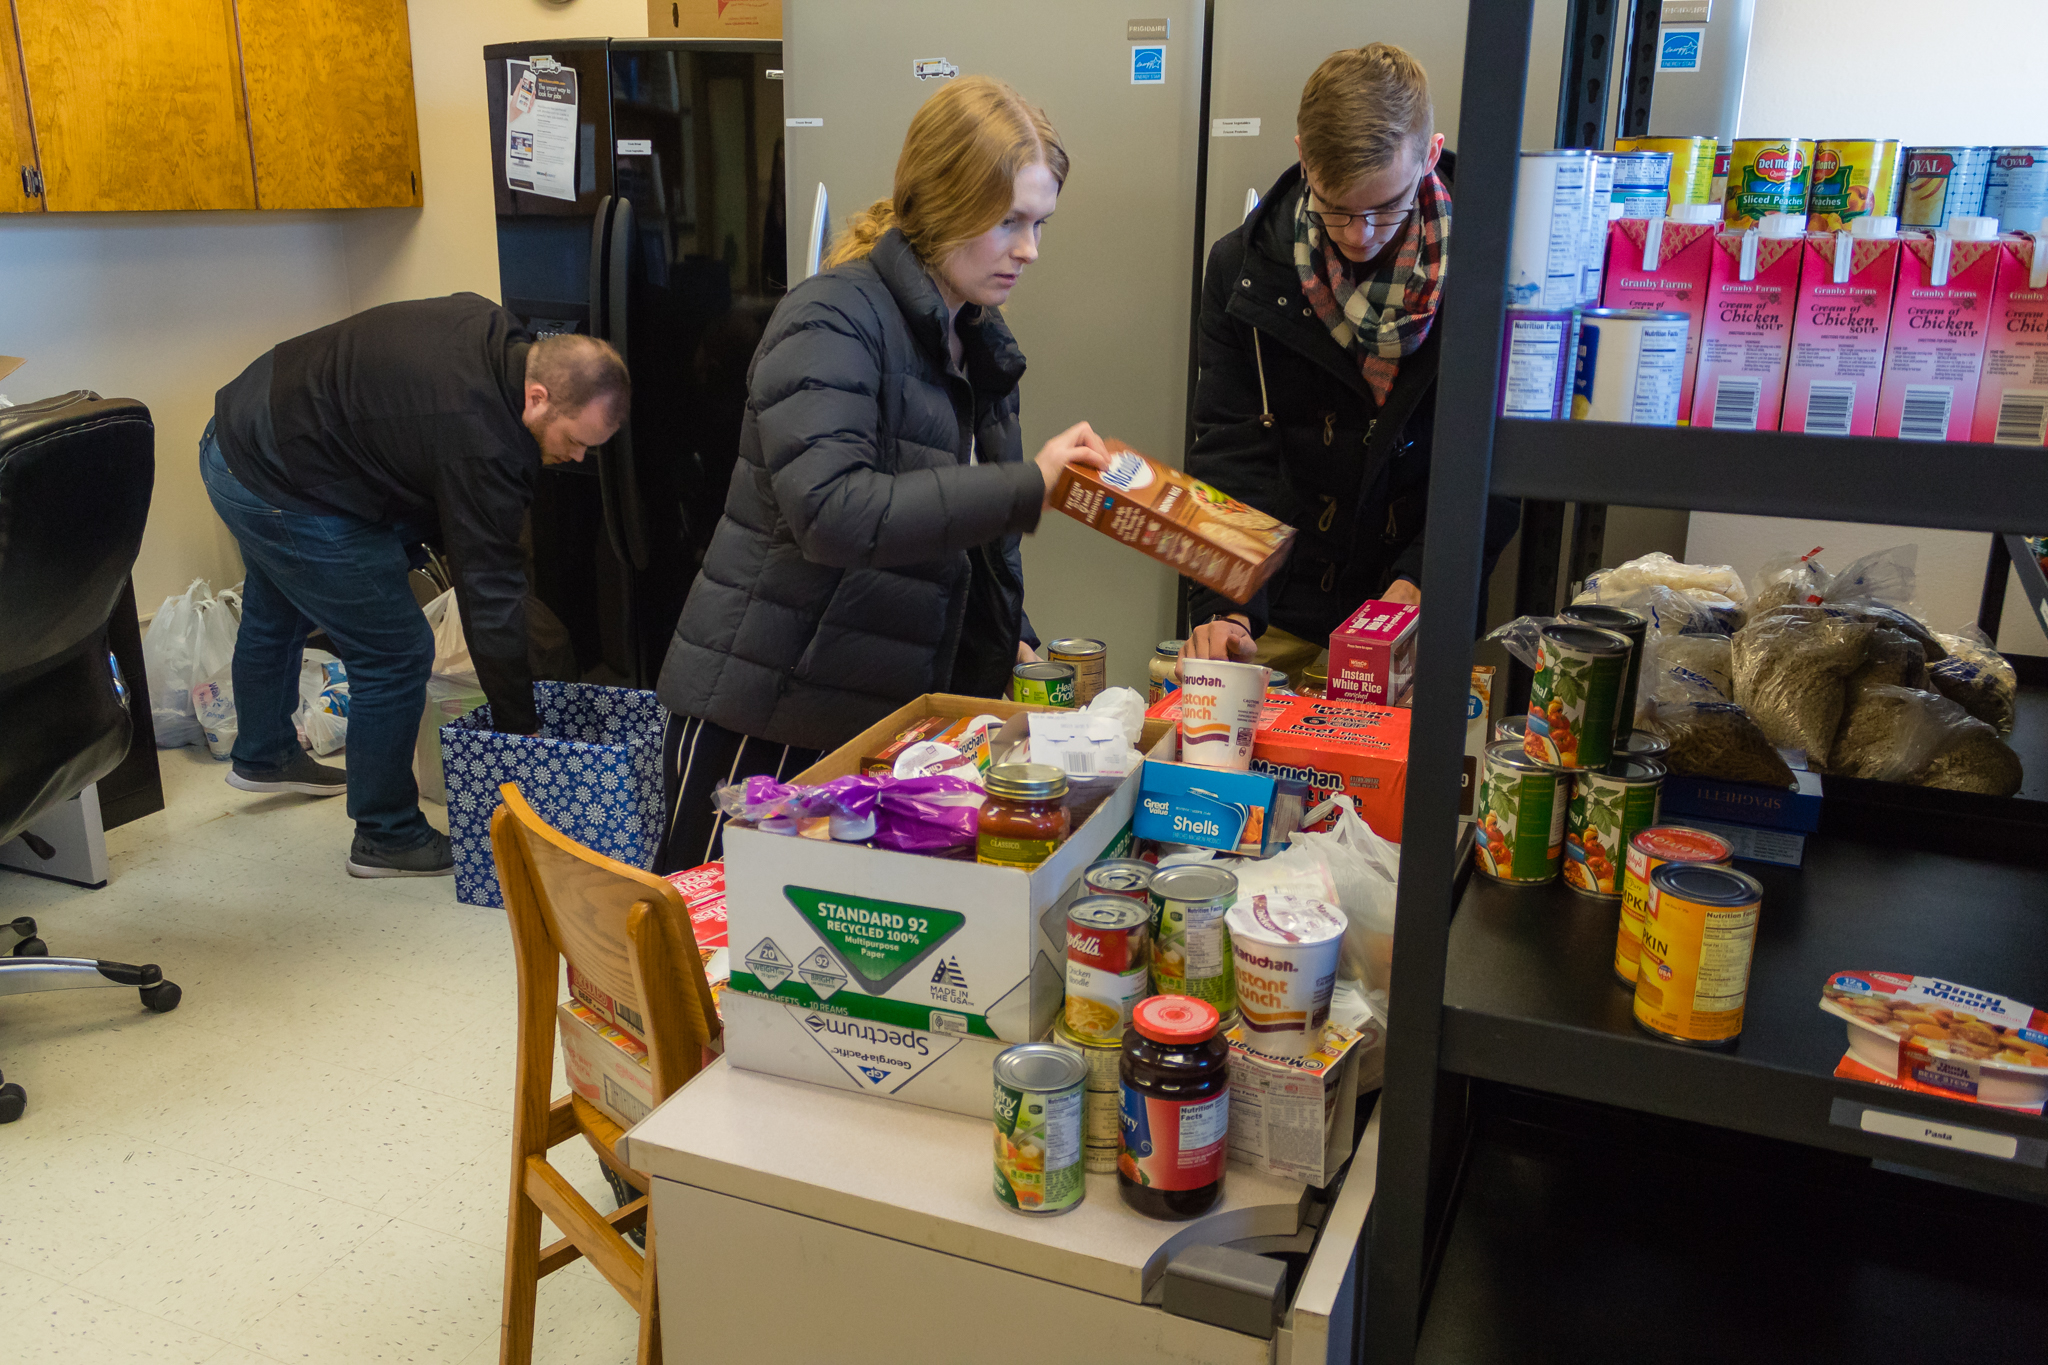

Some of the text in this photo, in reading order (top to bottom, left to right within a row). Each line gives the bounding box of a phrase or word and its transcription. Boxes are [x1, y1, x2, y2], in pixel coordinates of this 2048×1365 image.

[1758, 158, 1802, 169] Del Mote
[1908, 160, 1942, 176] OYAL
[2000, 158, 2028, 167] ROYAL
[1743, 195, 1803, 205] Sliced Peaches
[1811, 197, 1841, 206] Peaches
[1620, 278, 1693, 289] Granby Farms
[1722, 284, 1782, 293] Granby Farms
[1814, 287, 1877, 295] Granby Farms
[1911, 289, 1977, 298] Granby Farms
[2010, 292, 2044, 300] Granby
[1656, 300, 1666, 309] of
[1719, 301, 1767, 311] Cream of
[1811, 304, 1861, 314] Cream of
[1720, 309, 1779, 323] Chicken
[1908, 306, 1960, 316] Cream of
[2005, 310, 2044, 318] Cream
[1812, 312, 1874, 327] Chicken
[1909, 315, 1974, 330] Chicken
[1514, 322, 1562, 330] Nutrition Facts
[1755, 323, 1784, 331] SOUP
[1849, 326, 1879, 334] SOUP
[1350, 659, 1367, 667] WinCo
[1341, 668, 1375, 682] Instant
[1332, 678, 1382, 694] White Rice
[1344, 692, 1369, 700] enriched
[1183, 707, 1212, 720] unch
[1300, 716, 1329, 726] 6
[1272, 728, 1313, 737] Ramen
[1314, 732, 1358, 742] Noodle
[1359, 737, 1392, 747] Soup
[1289, 724, 1378, 740] Beef Flavor
[1250, 759, 1343, 791] Maruchan
[1144, 798, 1169, 811] Great
[1698, 788, 1782, 809] SPAGHETTI
[1149, 806, 1169, 816] Value
[1173, 815, 1219, 836] Shells
[990, 839, 1020, 849] CLASSICO
[817, 902, 928, 934] STANDARD 92
[1256, 910, 1275, 931] Chicken
[1706, 910, 1757, 920] Nutrition Facts
[826, 920, 920, 945] RECYCLED 100%
[844, 935, 900, 952] Multipurpose
[1066, 931, 1100, 957] pbell's
[1643, 927, 1668, 956] PKIN
[762, 948, 775, 960] 20
[861, 947, 886, 959] Paper
[816, 956, 828, 967] 92
[753, 964, 779, 973] WEIGHT
[1658, 968, 1671, 978] USA
[810, 973, 835, 984] BRIGHT
[1235, 965, 1288, 994] nstant
[1844, 977, 1862, 986] 12g
[930, 985, 969, 998] MADE IN
[1932, 980, 2002, 1006] Dinty
[770, 993, 800, 1006] SHEETS
[930, 992, 968, 1005] THE USA
[1922, 986, 2006, 1015] Moore
[809, 1001, 848, 1016] 10 REAMS
[1934, 998, 1960, 1007] ready
[1986, 1009, 2023, 1024] seconds
[826, 1018, 929, 1056] Spectrum
[2025, 1030, 2048, 1042] BEEF
[866, 1068, 884, 1079] GP
[1918, 1070, 1969, 1088] BEEF STEW
[1048, 1096, 1069, 1104] Nutrition
[1181, 1103, 1214, 1114] Nutrition
[1180, 1113, 1203, 1121] Facts
[1925, 1129, 1952, 1141] Pasta
